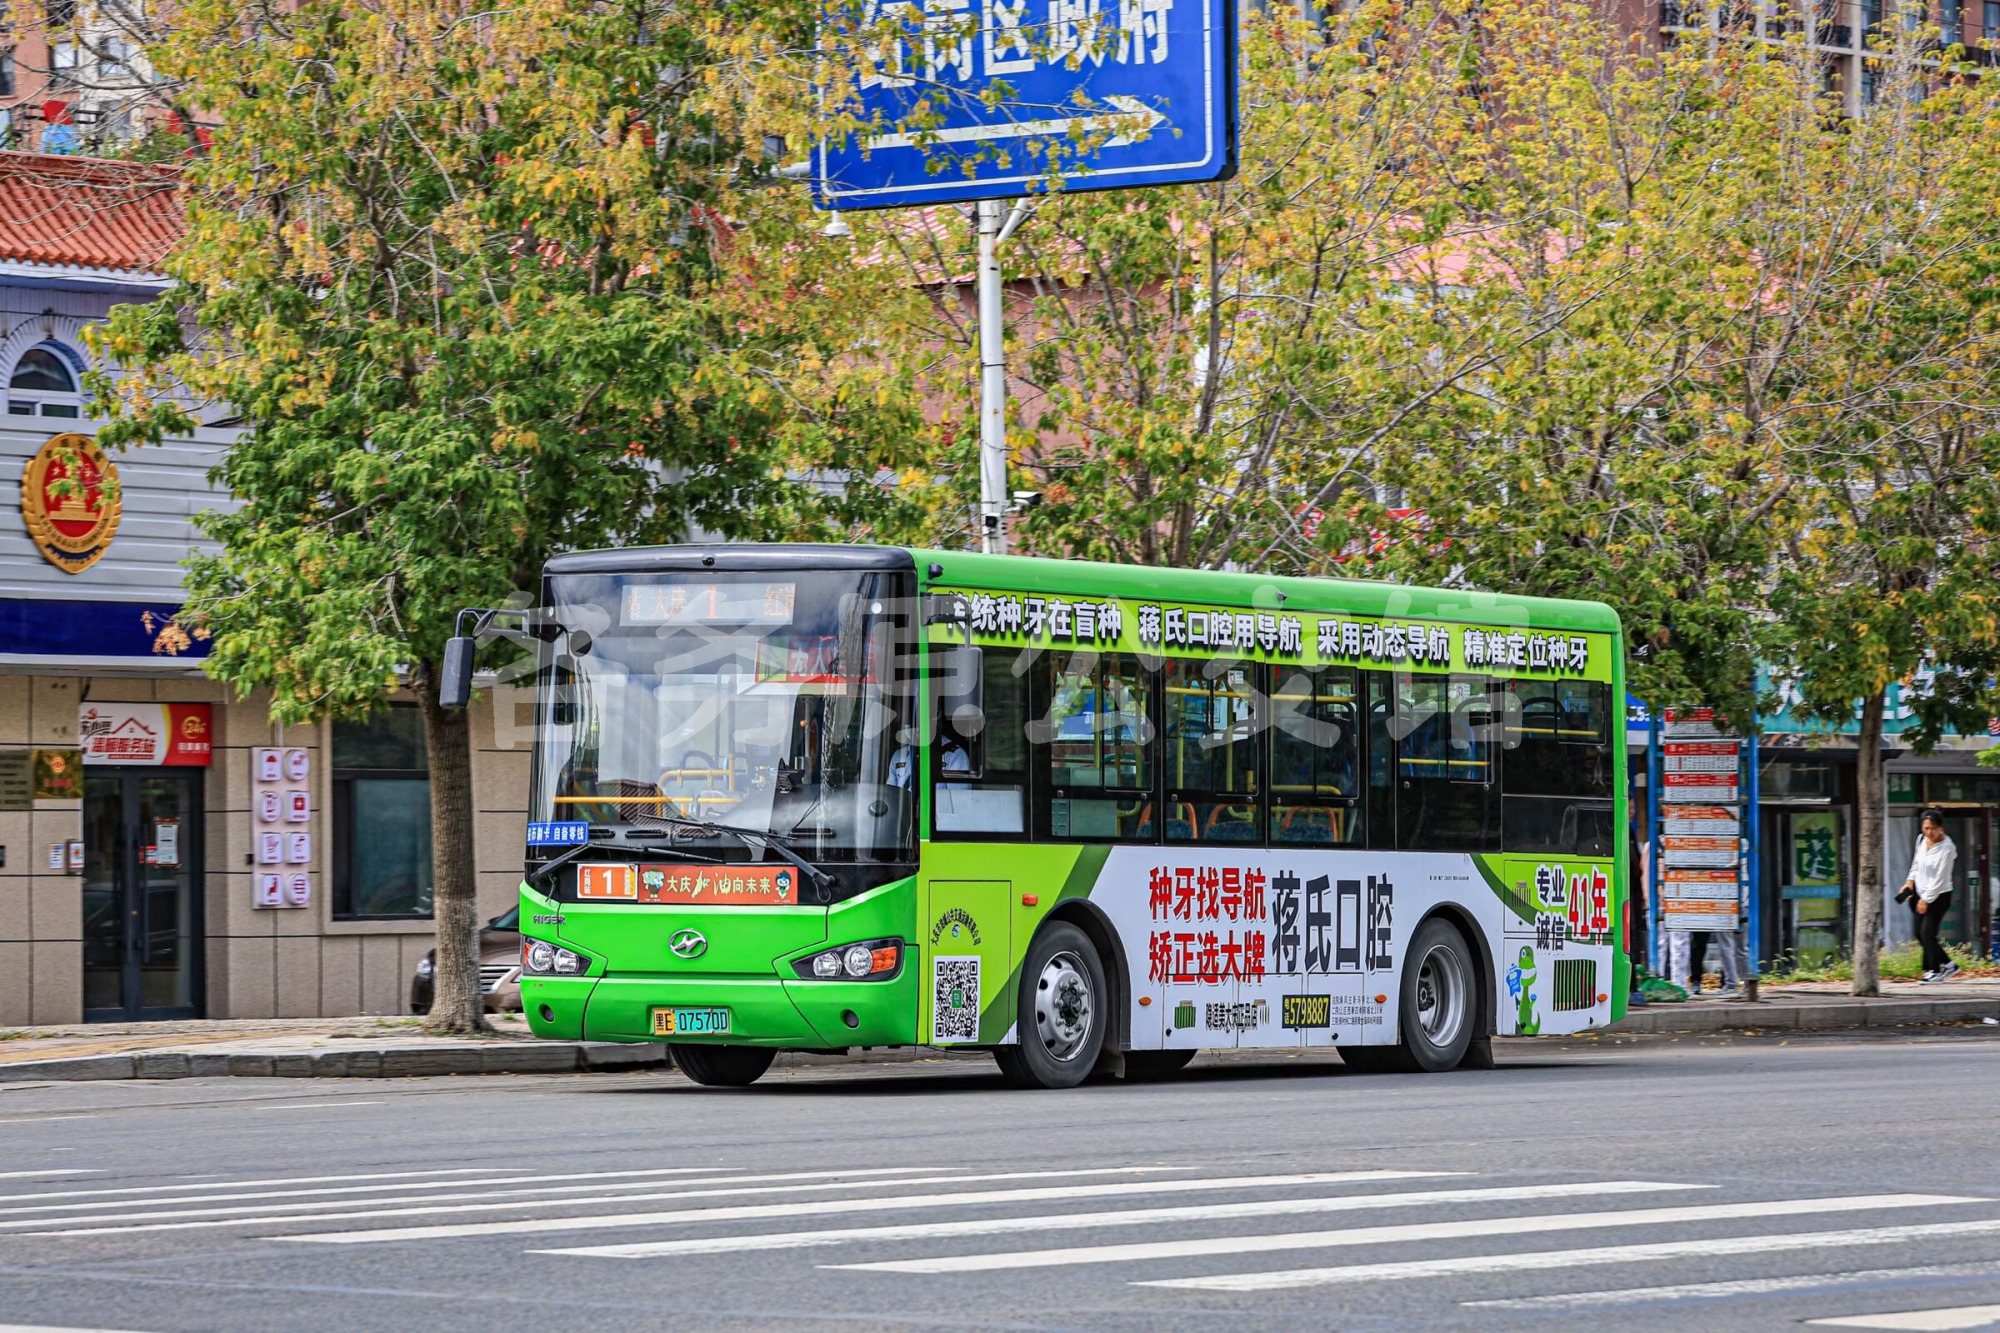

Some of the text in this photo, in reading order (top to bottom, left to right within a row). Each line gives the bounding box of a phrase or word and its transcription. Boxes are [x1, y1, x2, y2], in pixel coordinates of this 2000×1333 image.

[1138, 604, 1302, 651] 蒋氏口腔用导航
[1317, 619, 1450, 661] 采用动态导航
[1463, 628, 1588, 670] 精准定位种牙
[554, 826, 585, 841] 自备零钱
[602, 869, 613, 895] 1
[667, 869, 772, 899] 大庆加油向未来
[1149, 865, 1266, 921] 种牙找导航
[1536, 867, 1566, 904] 专业
[533, 915, 566, 924] HIGER
[1272, 870, 1394, 974] 蒋氏口腔
[1569, 870, 1608, 945] 41年
[1536, 912, 1565, 951] 诚信
[1149, 930, 1266, 984] 矫正选大牌
[678, 1011, 729, 1031] 07570D
[1290, 997, 1329, 1025] 5798887
